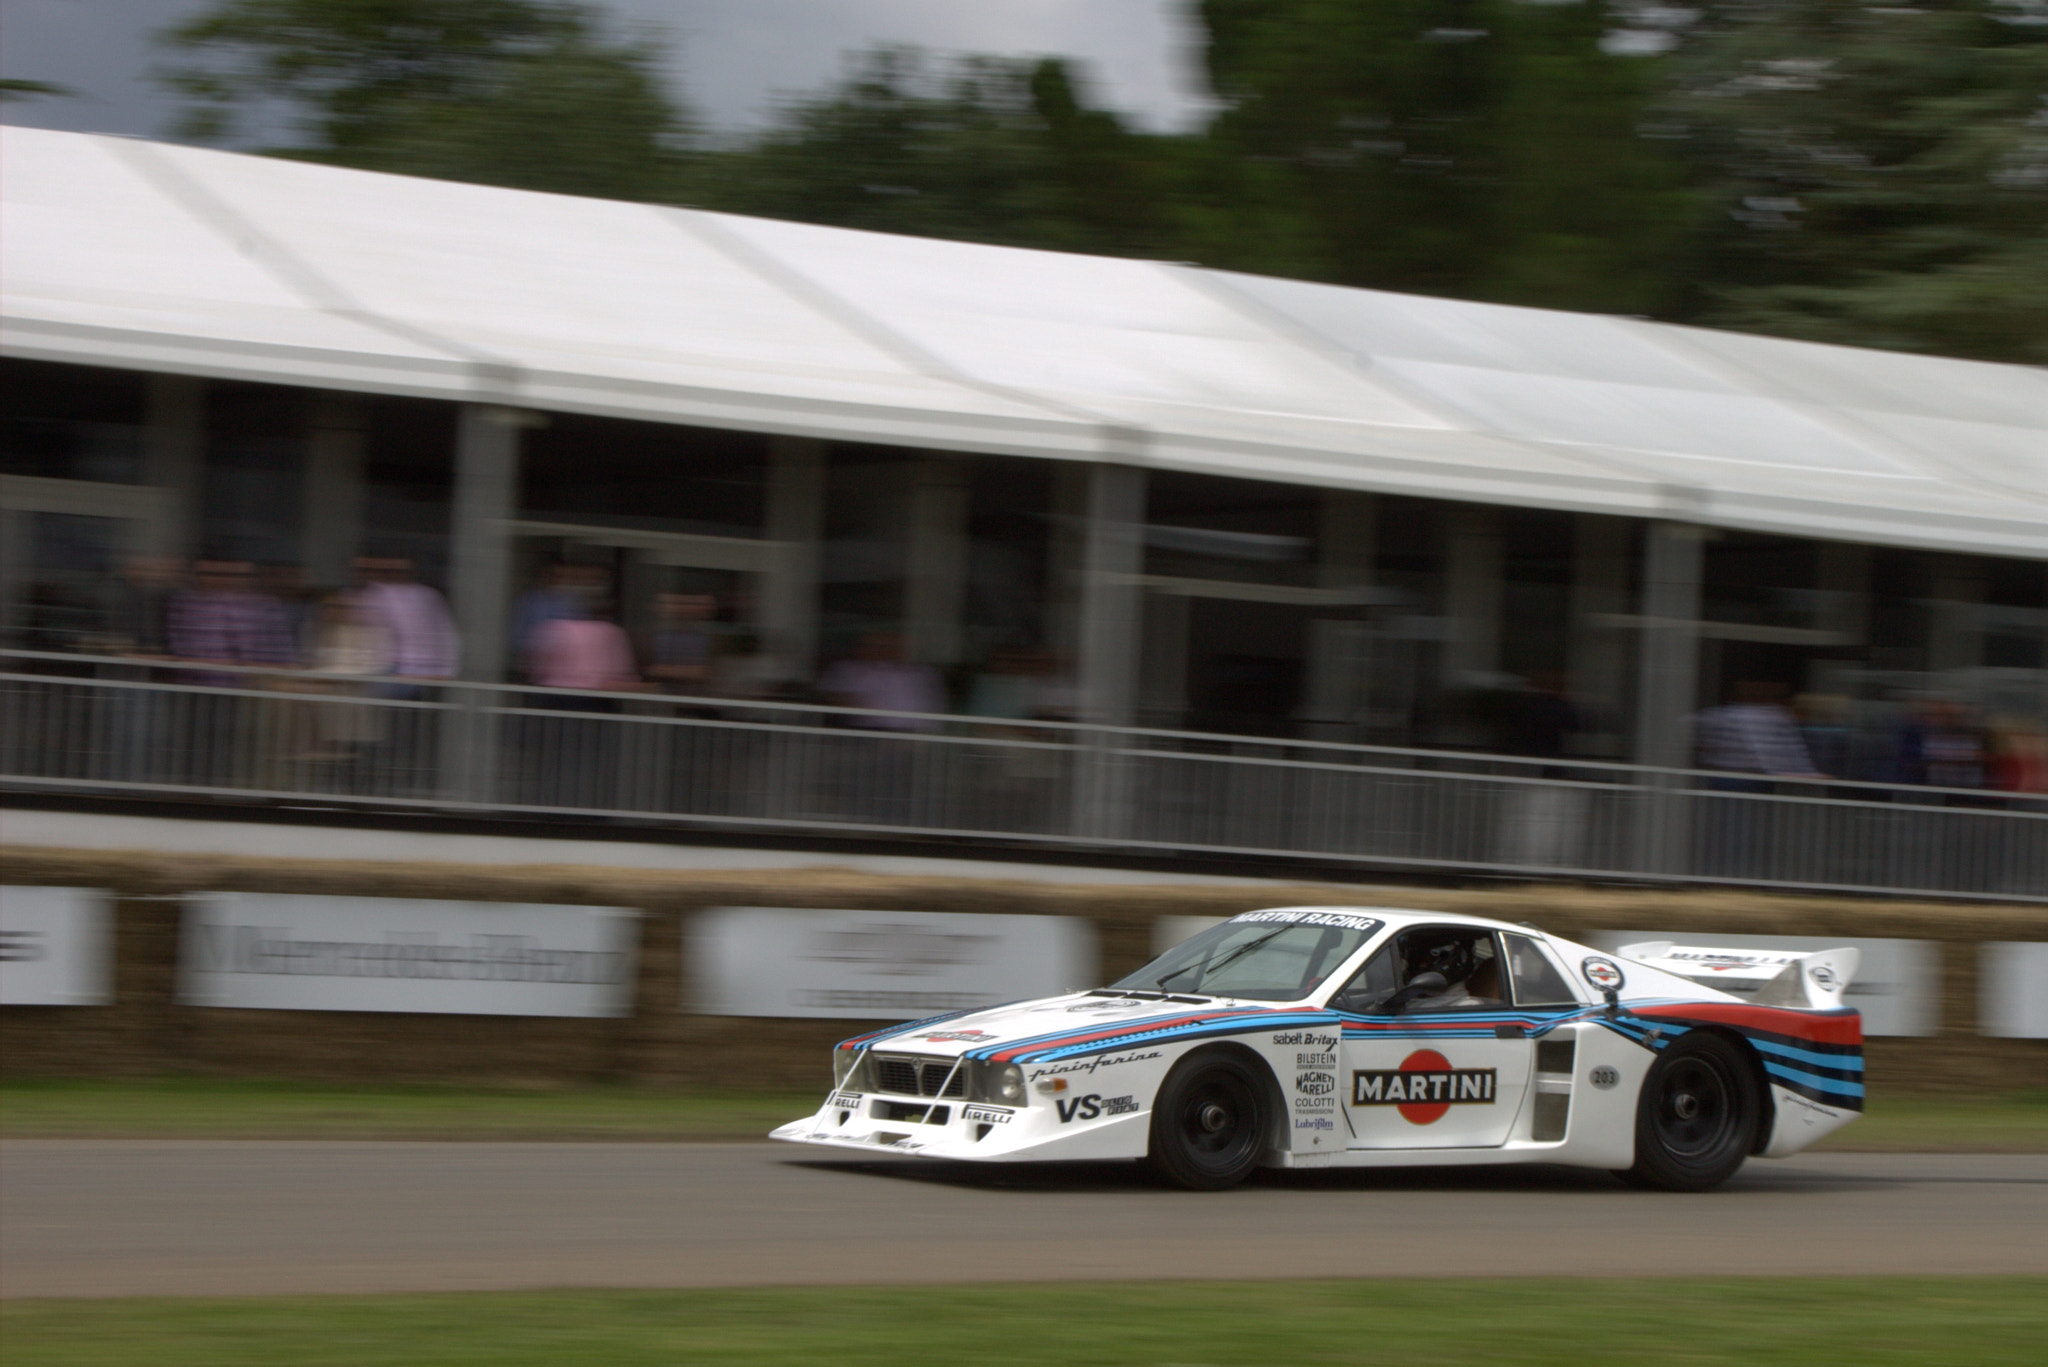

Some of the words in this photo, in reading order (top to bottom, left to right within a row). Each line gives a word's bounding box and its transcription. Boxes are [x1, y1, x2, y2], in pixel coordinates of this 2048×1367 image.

[1230, 912, 1304, 924] MARTINI
[1302, 912, 1374, 931] RACING
[1273, 1033, 1302, 1045] sabelt
[1303, 1033, 1338, 1052] Britax
[1028, 1051, 1163, 1082] pininfarina
[1296, 1053, 1336, 1064] BILSTEIN
[1296, 1072, 1335, 1087] MAGNETI
[1594, 1070, 1615, 1084] 203
[1357, 1073, 1492, 1101] MARTINI
[827, 1090, 863, 1109] PRELLI
[1056, 1094, 1102, 1123] VS
[1295, 1098, 1335, 1108] COLOTTI
[961, 1103, 1015, 1124] PIRELLI
[1294, 1117, 1334, 1130] Lubrifilm
